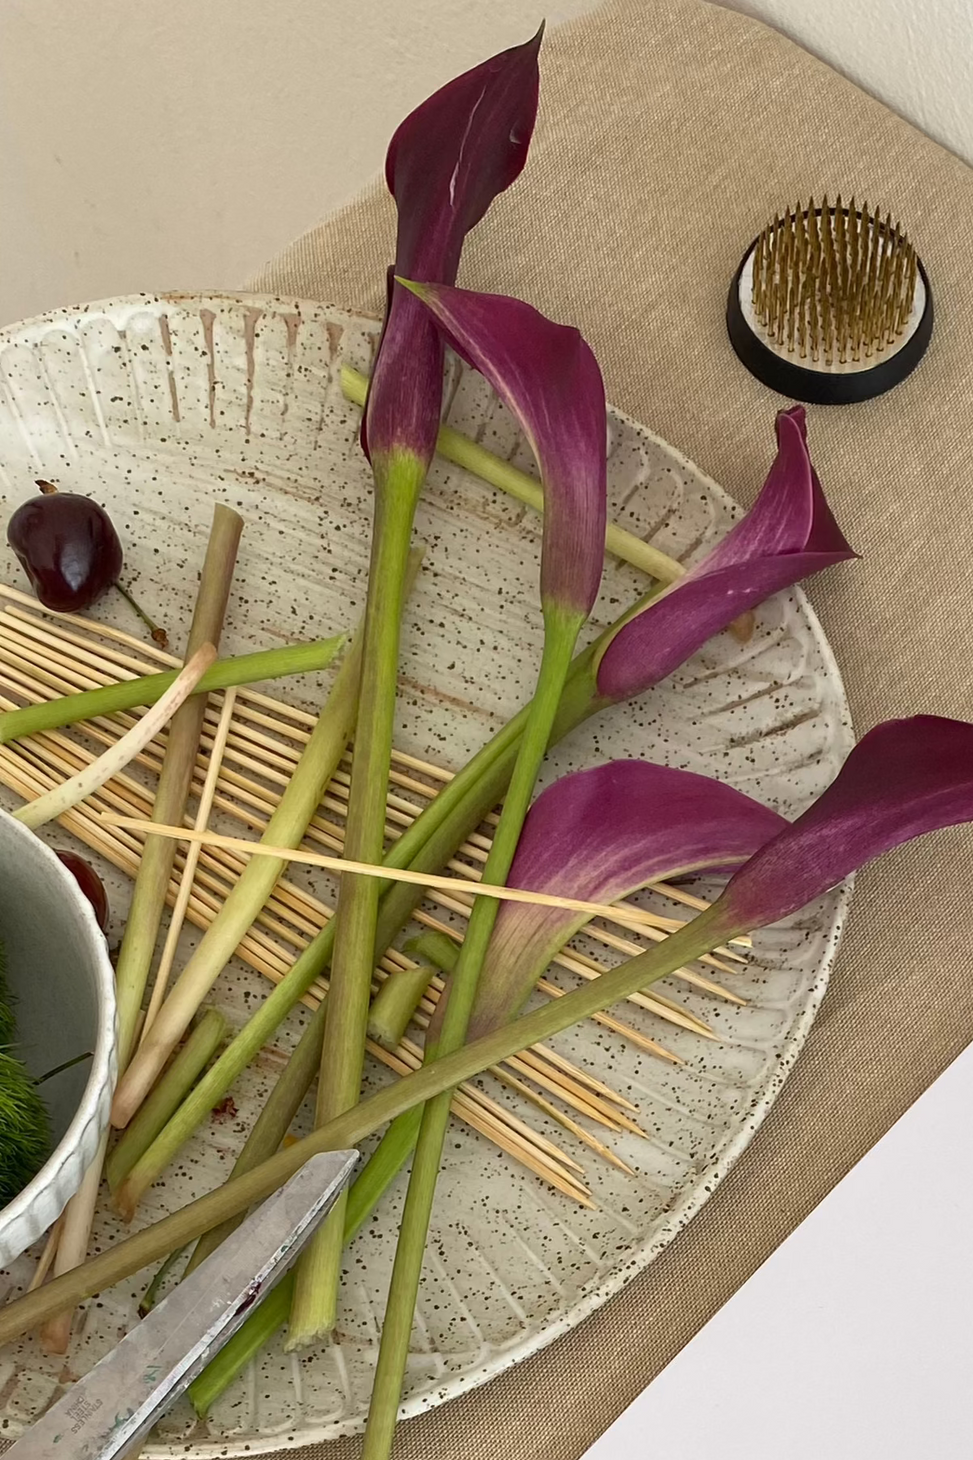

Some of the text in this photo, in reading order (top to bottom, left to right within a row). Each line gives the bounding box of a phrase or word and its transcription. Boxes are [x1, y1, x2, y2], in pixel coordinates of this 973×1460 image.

[64, 1396, 84, 1417] CHINA
[70, 1400, 91, 1423] STEEL
[70, 1398, 103, 1435] STAINLESS
